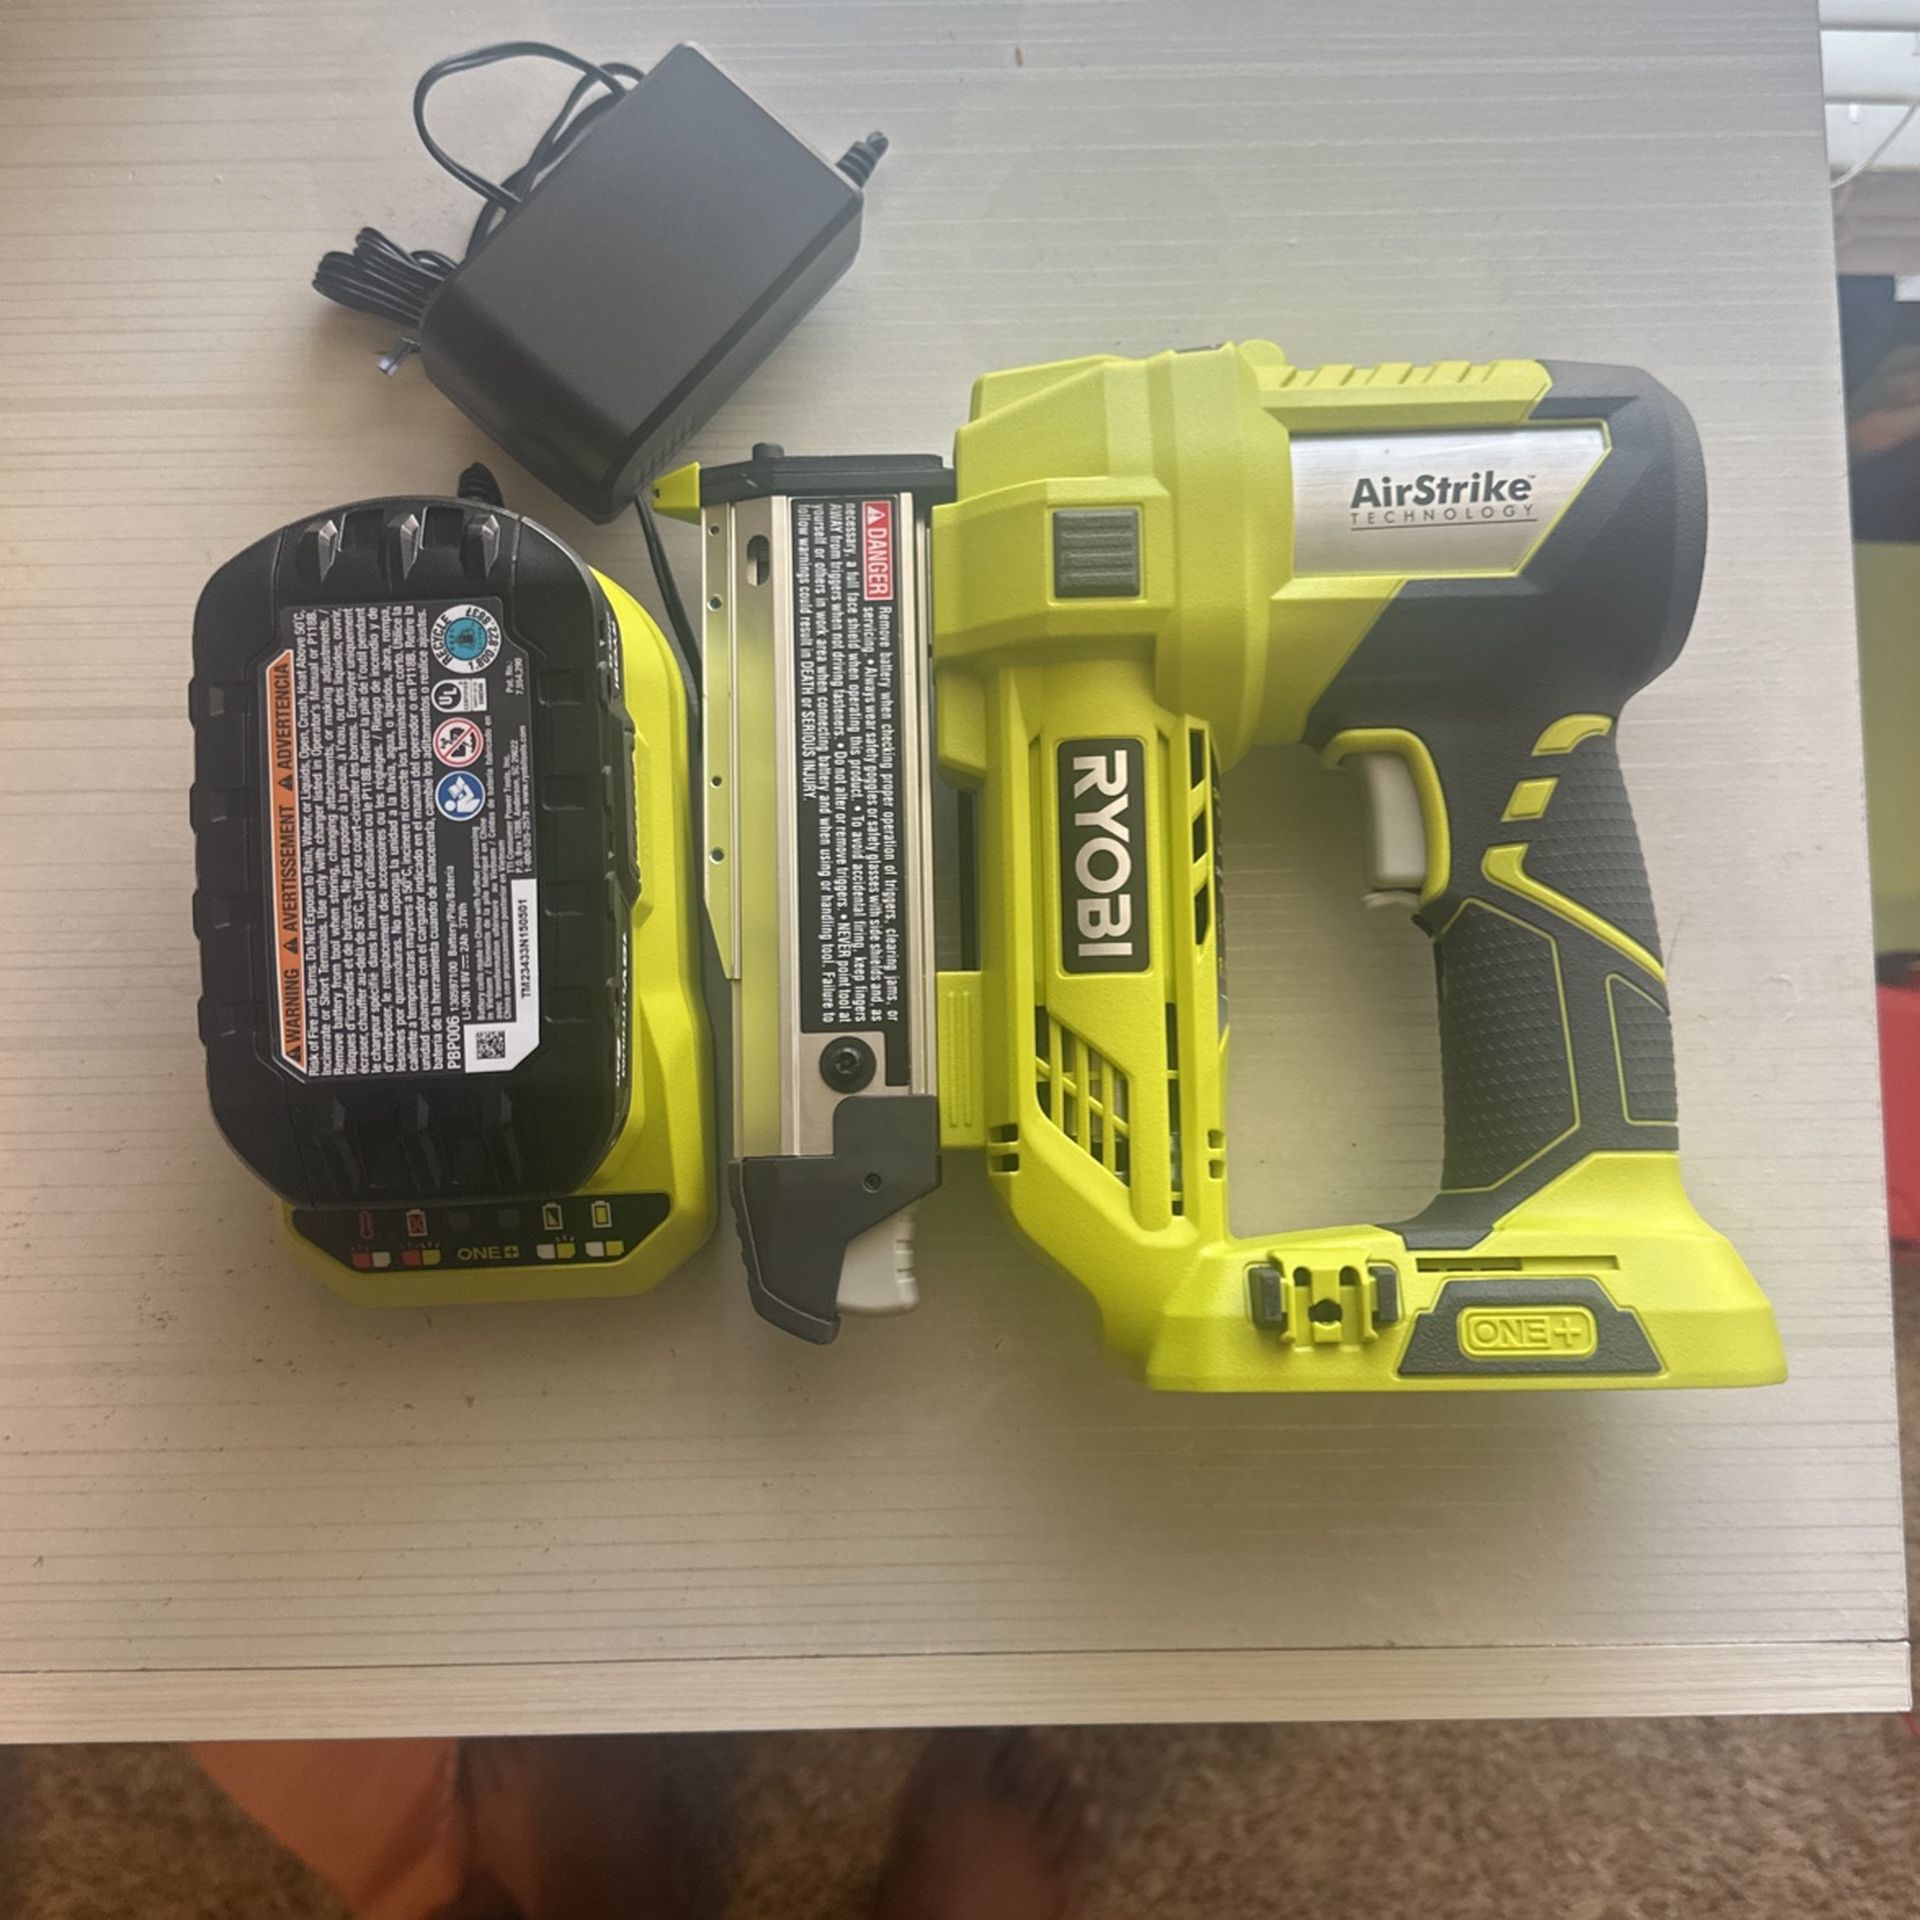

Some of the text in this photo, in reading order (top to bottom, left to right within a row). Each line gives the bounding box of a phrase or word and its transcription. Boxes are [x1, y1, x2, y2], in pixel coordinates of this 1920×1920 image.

[1350, 470, 1532, 508] AirStrike
[1350, 504, 1534, 525] TECHNOLOGY
[868, 528, 888, 594] DANGER
[296, 637, 307, 669] Above
[311, 648, 318, 660] or
[432, 614, 453, 666] RECYCLE
[796, 504, 816, 800] follow warnings could result in DEATH or SERIOUS INJURY.
[297, 670, 308, 694] Heat
[308, 662, 320, 701] Manual
[321, 686, 334, 726] making
[325, 729, 333, 741] or
[311, 759, 322, 770] in
[812, 503, 835, 1023] yourself or others in work area when connecting battery and when using or handling tool. Failure to
[828, 503, 851, 1022] AWAY from triggers when not driving fasteners. Do not alter or remove triggers. NEVER point tool at
[843, 502, 867, 1022] necessary, a full face shield when operating this product. To avoid accidental firing, keep fingers
[312, 772, 323, 802] listed
[304, 802, 311, 813] or
[861, 606, 883, 1021] servicing. Always wear safety goggles or safety glasses with side shields and, as
[878, 606, 899, 1020] Remove battery when checking proper operation of triggers, clearing jams, or
[313, 805, 326, 845] charger
[325, 814, 339, 862] changing
[274, 664, 300, 1044] WARNING AVERTISSEMENT ADVERTENCIA
[314, 847, 325, 871] with
[1073, 749, 1133, 957] RYOBI
[303, 875, 314, 886] to
[315, 874, 327, 896] only
[304, 888, 316, 925] Expose
[316, 899, 326, 919] Use
[305, 926, 315, 945] Not
[328, 908, 339, 937] when
[305, 946, 316, 961] Do
[329, 940, 340, 960] tool
[330, 963, 341, 989] from
[307, 997, 317, 1017] and
[318, 978, 329, 1006] Short
[322, 1009, 329, 1021] or
[331, 992, 344, 1030] battery
[308, 1019, 318, 1039] Fire
[446, 1016, 461, 1069] PBP006
[308, 1041, 319, 1052] of
[319, 1024, 331, 1076] Incinerate
[332, 1032, 344, 1076] Remove
[309, 1053, 319, 1076] Risk
